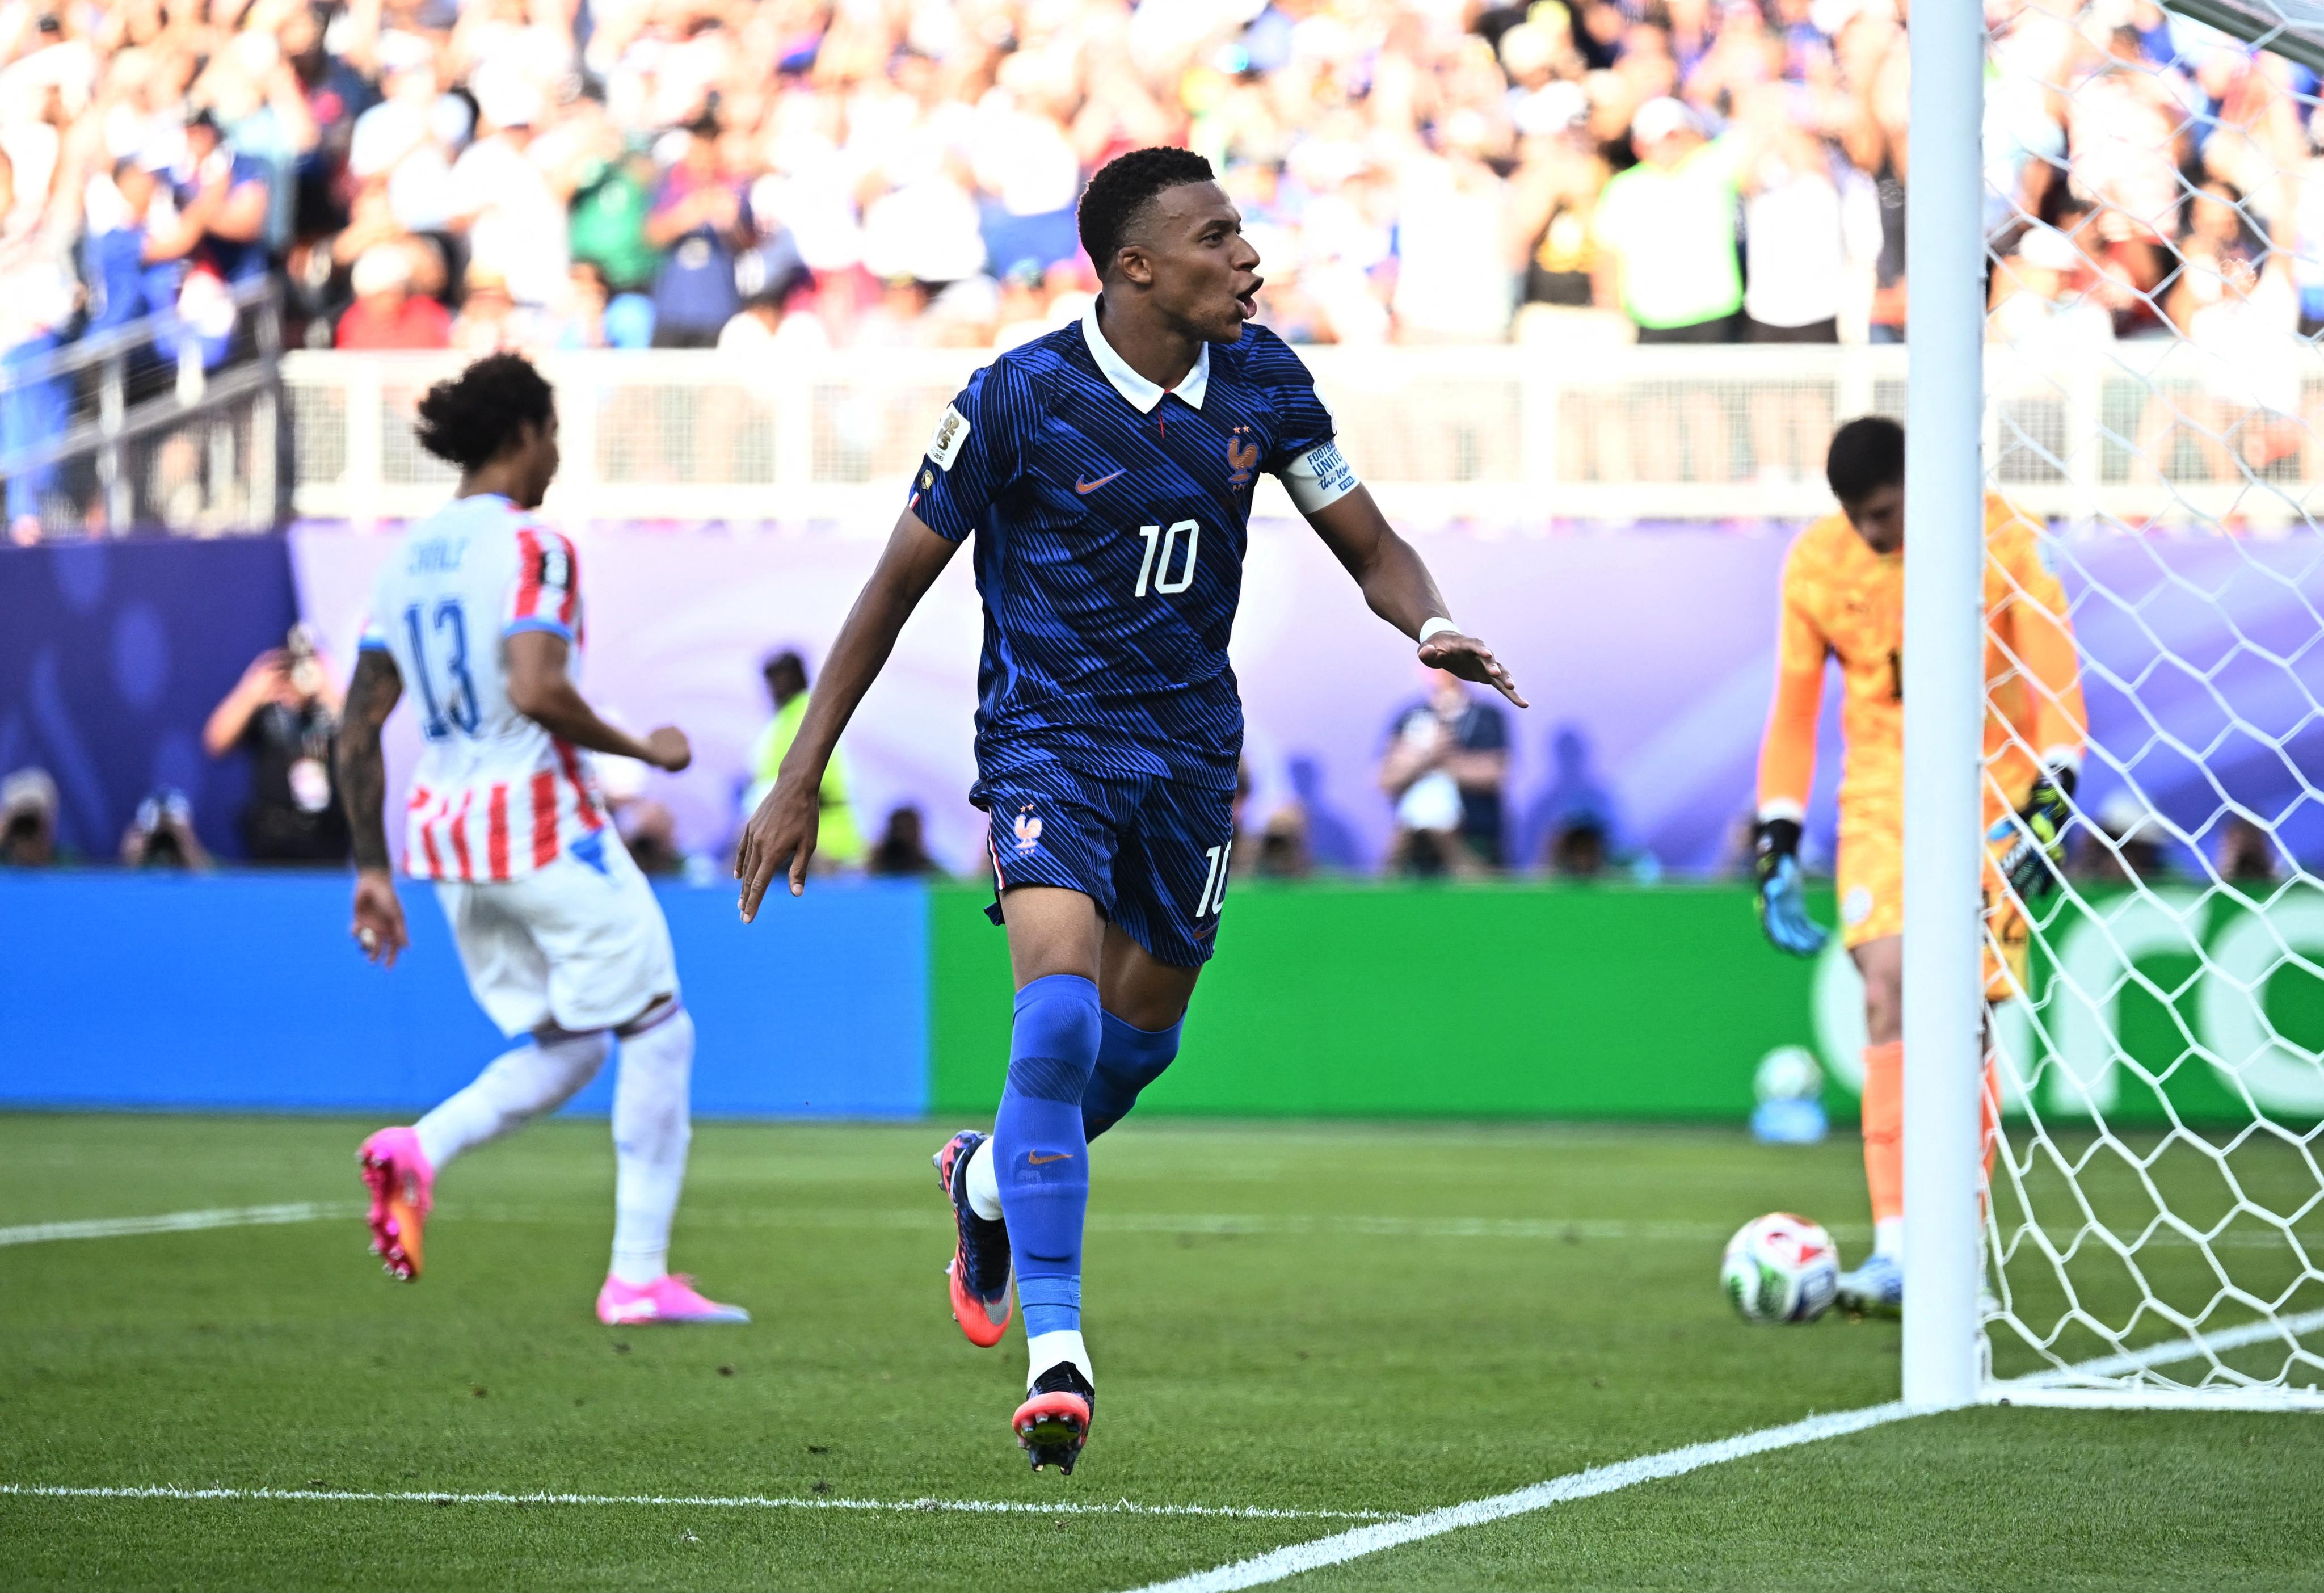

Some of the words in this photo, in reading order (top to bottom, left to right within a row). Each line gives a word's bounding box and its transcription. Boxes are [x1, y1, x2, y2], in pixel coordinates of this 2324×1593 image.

[1318, 476, 1336, 490] the
[1135, 519, 1199, 598] 10
[403, 598, 481, 740] 13
